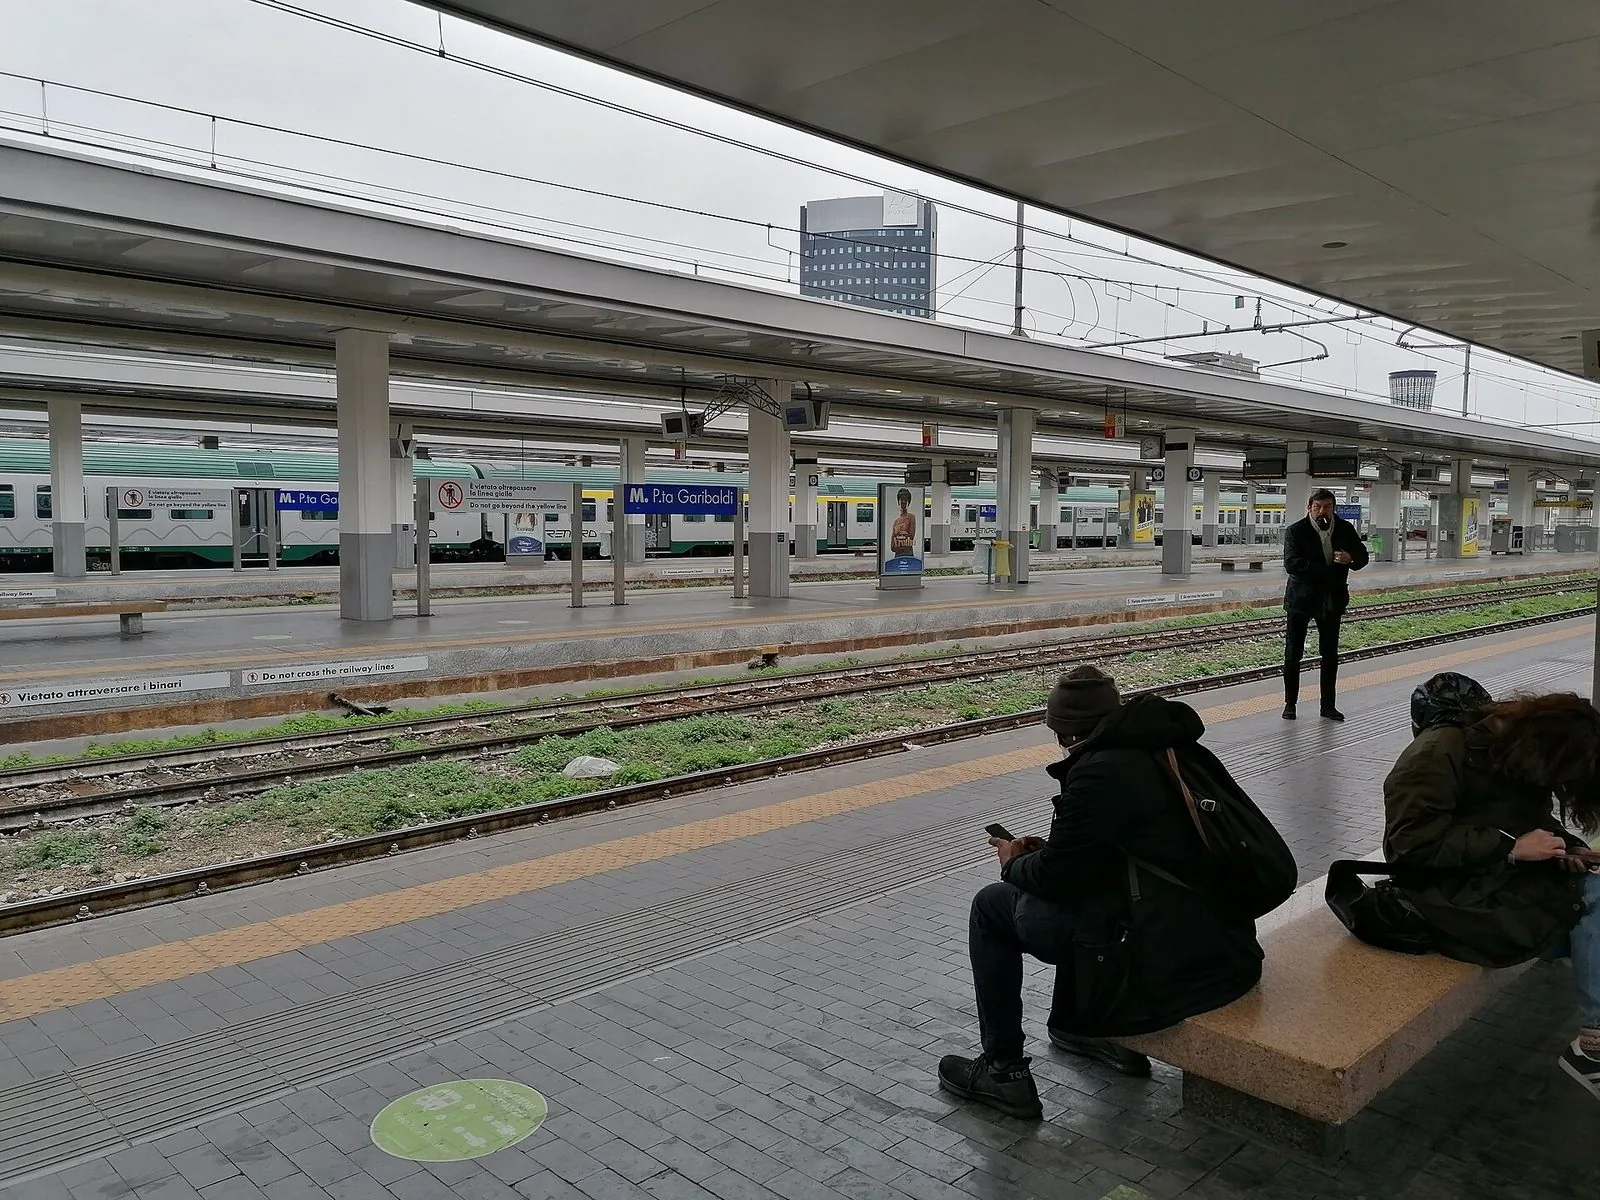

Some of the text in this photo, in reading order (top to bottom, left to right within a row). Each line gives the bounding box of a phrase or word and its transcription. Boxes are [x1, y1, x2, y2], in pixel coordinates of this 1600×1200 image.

[279, 492, 296, 504] M.
[299, 492, 317, 504] P.ta
[629, 487, 734, 505] M. P.ta Garibaldi
[501, 502, 524, 510] beyond
[262, 663, 395, 681] Do not cross the railway lines
[17, 690, 63, 702] Vietato
[67, 684, 140, 699] attraversare
[149, 679, 182, 690] binari
